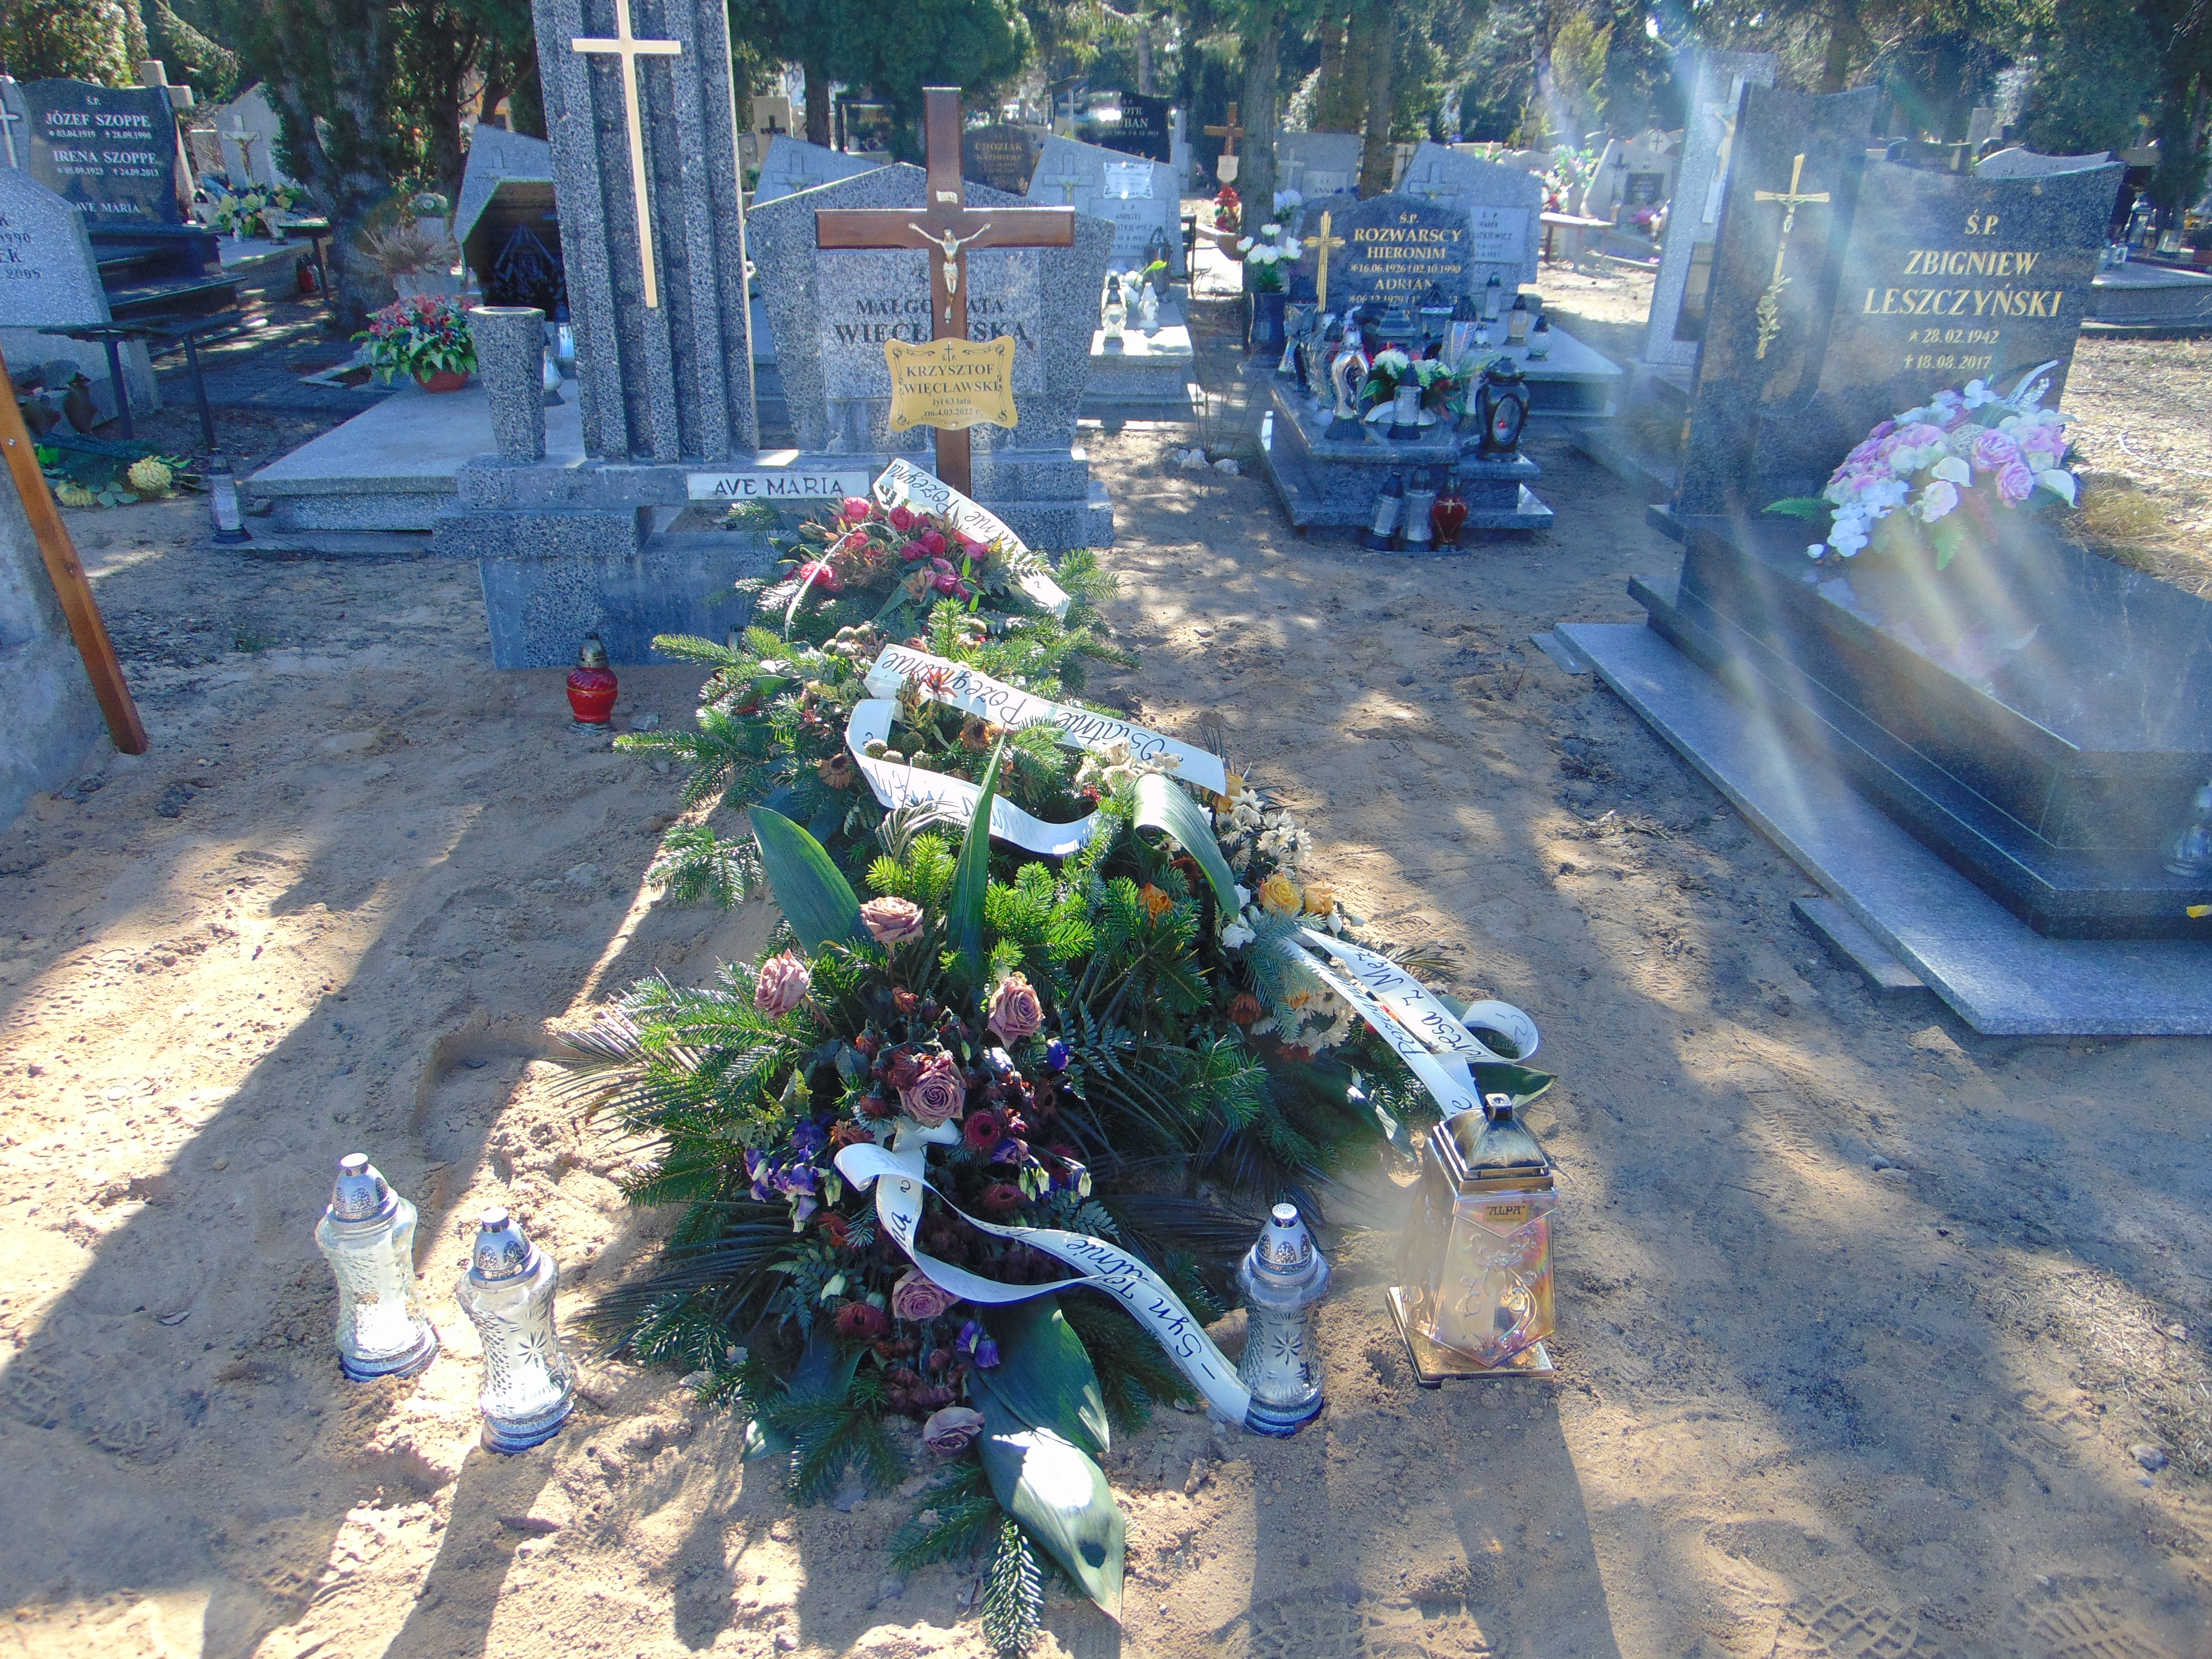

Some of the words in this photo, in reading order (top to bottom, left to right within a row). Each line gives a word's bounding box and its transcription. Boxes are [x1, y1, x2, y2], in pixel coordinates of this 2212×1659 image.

[46, 109, 89, 125] JÓZEF
[96, 115, 151, 127] SZOPPE
[54, 151, 99, 162] IRENA
[103, 152, 158, 164] SZOPPE
[76, 202, 97, 212] AVE
[101, 203, 141, 213] MARIA
[1399, 211, 1419, 223] Ś.P.
[1354, 228, 1462, 242] ROZWARSCY
[1367, 246, 1446, 258] HIERONIM
[1903, 250, 2040, 276] ZBIGNIEW
[1374, 278, 1433, 290] ADRIAN
[857, 298, 1005, 316] MAŁGOATA
[1862, 283, 2063, 317] LESZCZYŃSKI
[906, 364, 995, 377] KRZYSZTOF
[902, 381, 999, 396] WIĘCŁAWSKI
[714, 478, 757, 496] AVE
[766, 477, 845, 495] MARIA
[1401, 989, 1425, 1006] z
[1149, 1297, 1203, 1359] Syn
